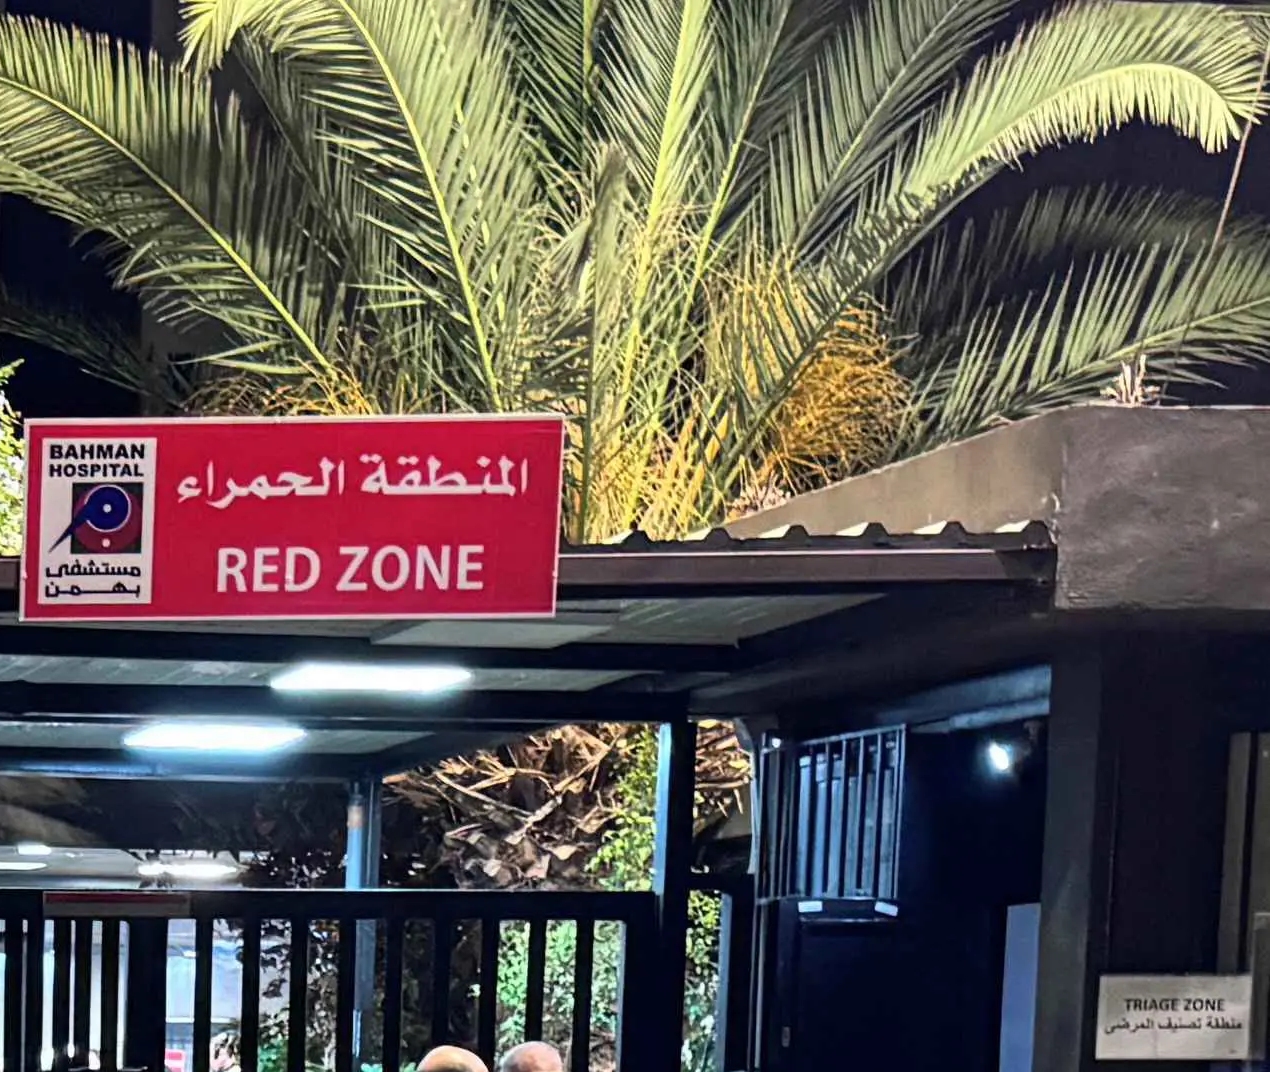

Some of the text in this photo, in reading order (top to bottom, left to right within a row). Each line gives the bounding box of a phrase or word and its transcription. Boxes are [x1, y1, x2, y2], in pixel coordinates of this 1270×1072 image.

[49, 443, 146, 460] BAHMAN
[48, 463, 145, 478] HOSPITAL
[176, 453, 529, 510] المنطقة الحمراء
[45, 558, 142, 578] مستشفى
[216, 544, 485, 593] RED ZONE
[44, 581, 141, 599] بهمن
[1124, 998, 1226, 1012] TRIAGE ZONE
[1105, 1016, 1243, 1034] منطقة تصنيف المرضى
